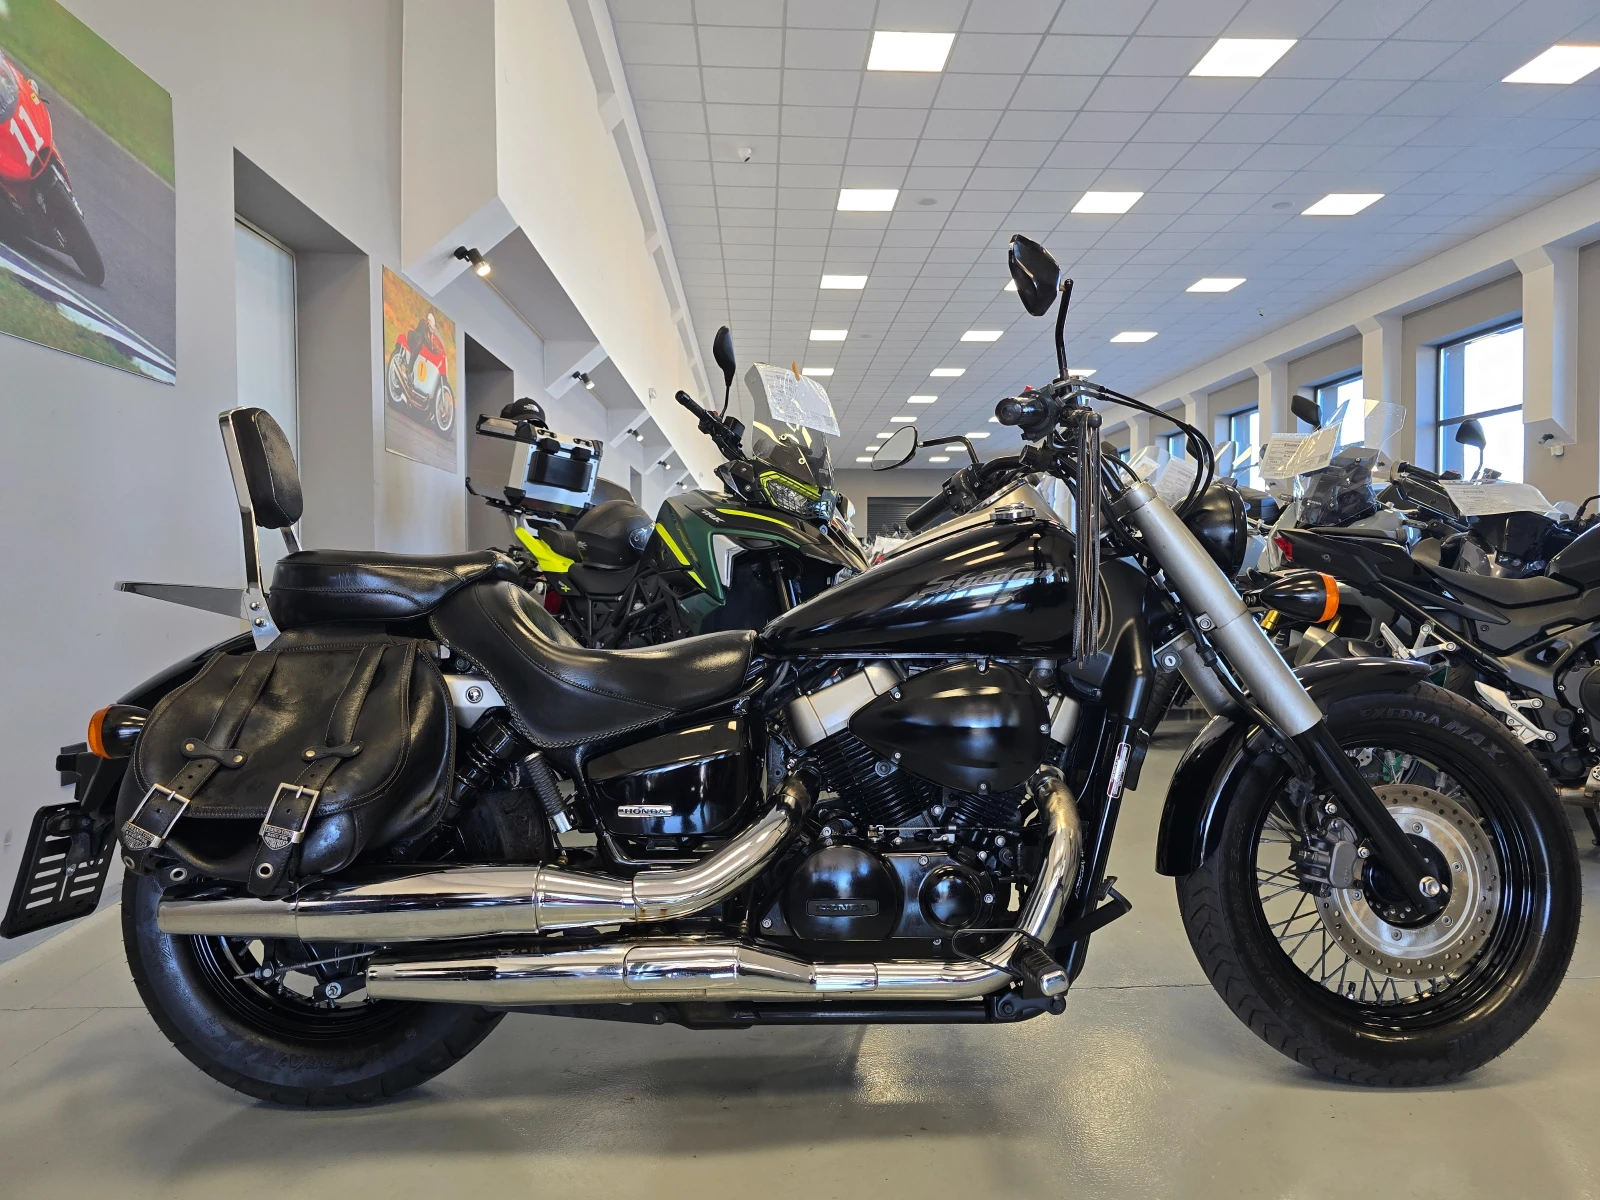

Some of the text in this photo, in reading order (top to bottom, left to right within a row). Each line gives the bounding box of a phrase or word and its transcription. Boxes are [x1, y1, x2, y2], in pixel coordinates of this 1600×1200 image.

[10, 105, 44, 167] 11
[1360, 707, 1505, 761] EXEDRA MAX
